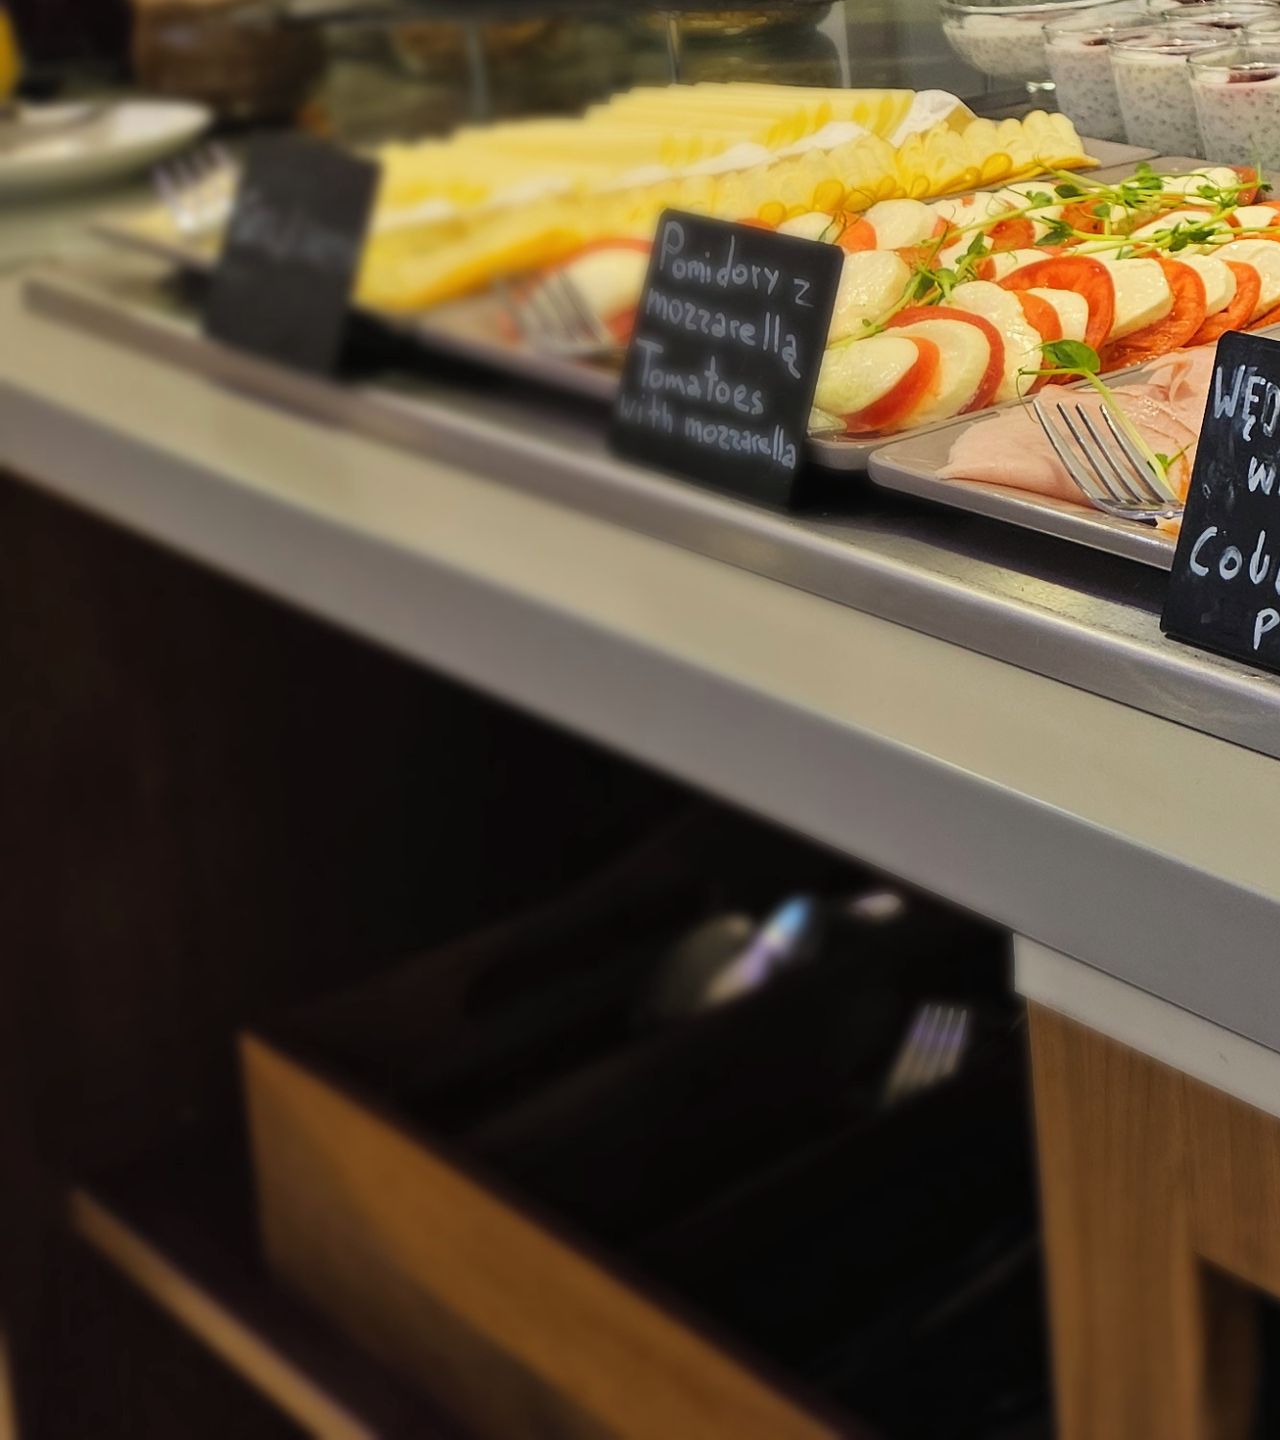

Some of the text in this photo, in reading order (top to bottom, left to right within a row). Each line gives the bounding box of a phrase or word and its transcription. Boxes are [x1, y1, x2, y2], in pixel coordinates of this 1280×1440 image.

[659, 220, 779, 295] Pomidory
[637, 337, 764, 415] Tomatoes
[684, 424, 798, 470] mozzarella
